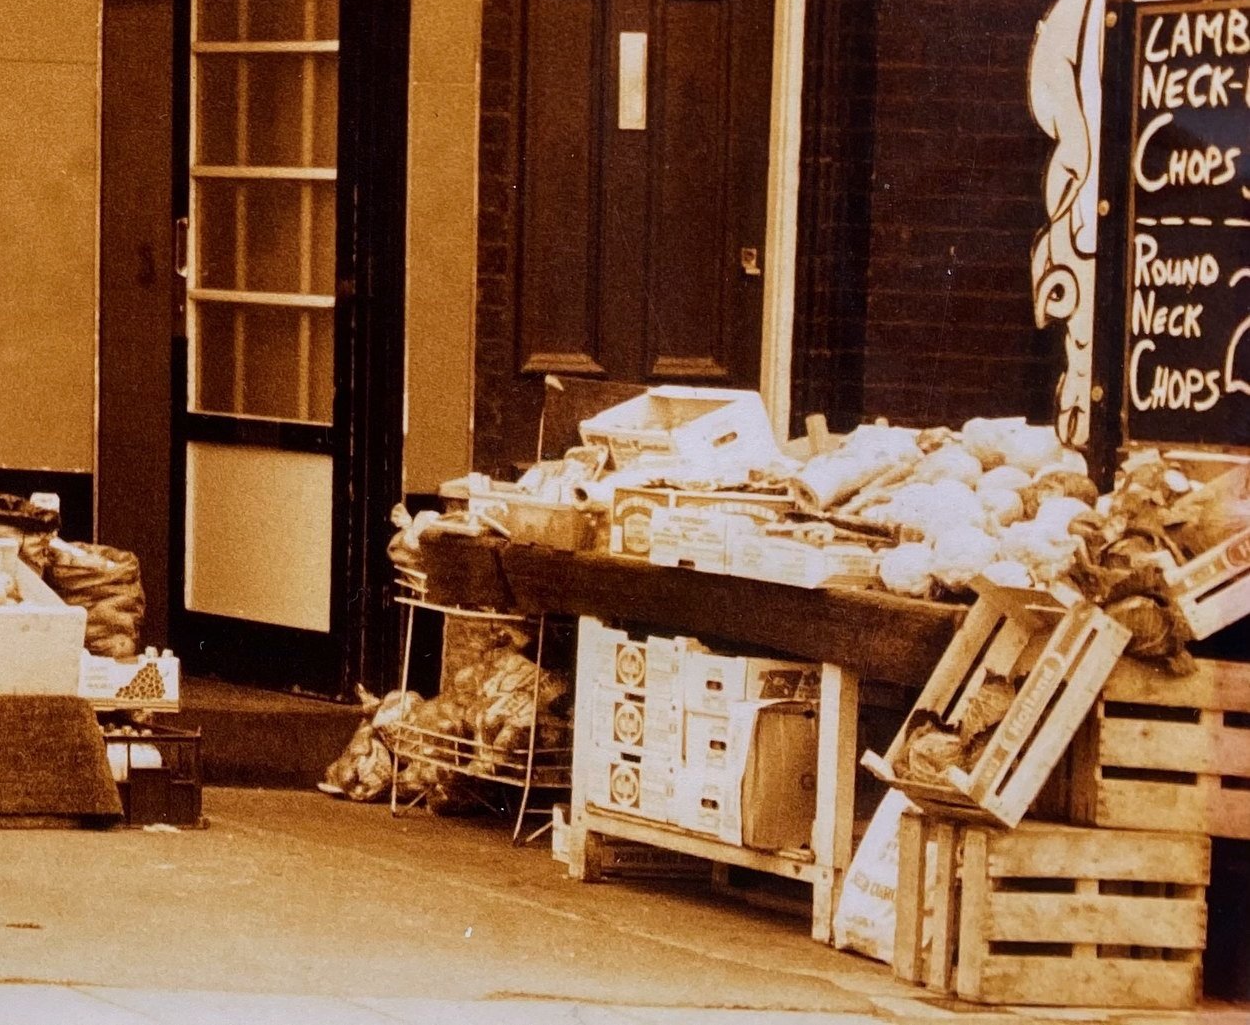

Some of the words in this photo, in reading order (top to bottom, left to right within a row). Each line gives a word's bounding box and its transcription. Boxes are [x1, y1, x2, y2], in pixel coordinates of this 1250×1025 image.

[1134, 112, 1242, 193] CHOPS
[1134, 233, 1220, 288] ROUND
[1132, 289, 1204, 339] NECK
[1129, 339, 1221, 412] CHOPS
